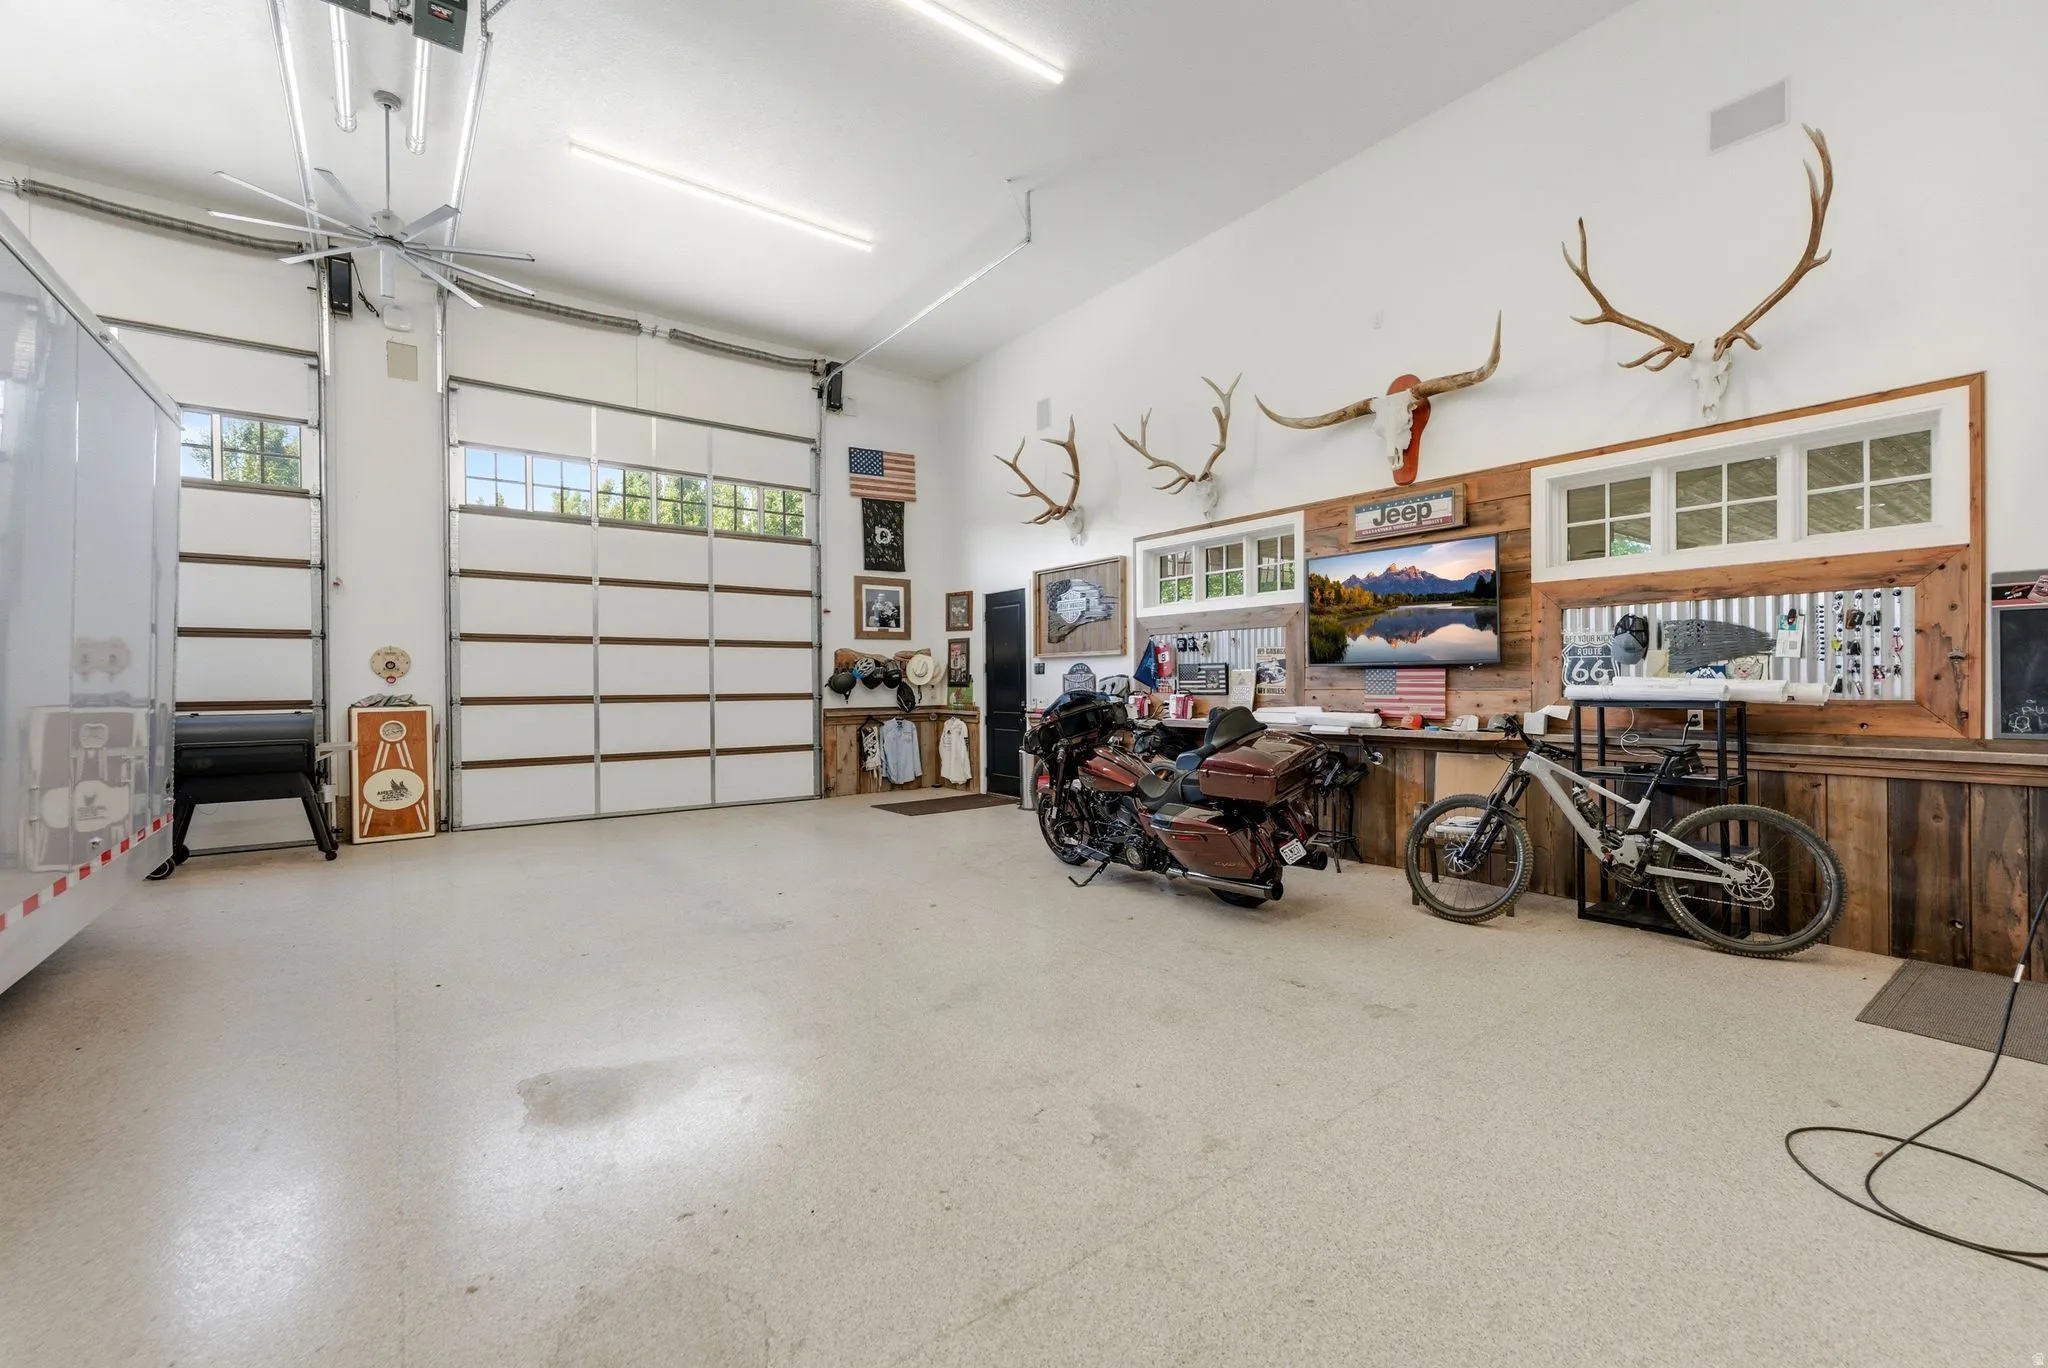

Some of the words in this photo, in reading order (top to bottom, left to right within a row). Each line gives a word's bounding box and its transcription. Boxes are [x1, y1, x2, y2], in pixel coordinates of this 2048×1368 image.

[1372, 501, 1432, 527] Jeep
[1577, 647, 1603, 656] ROUTE
[1571, 658, 1610, 682] 66
